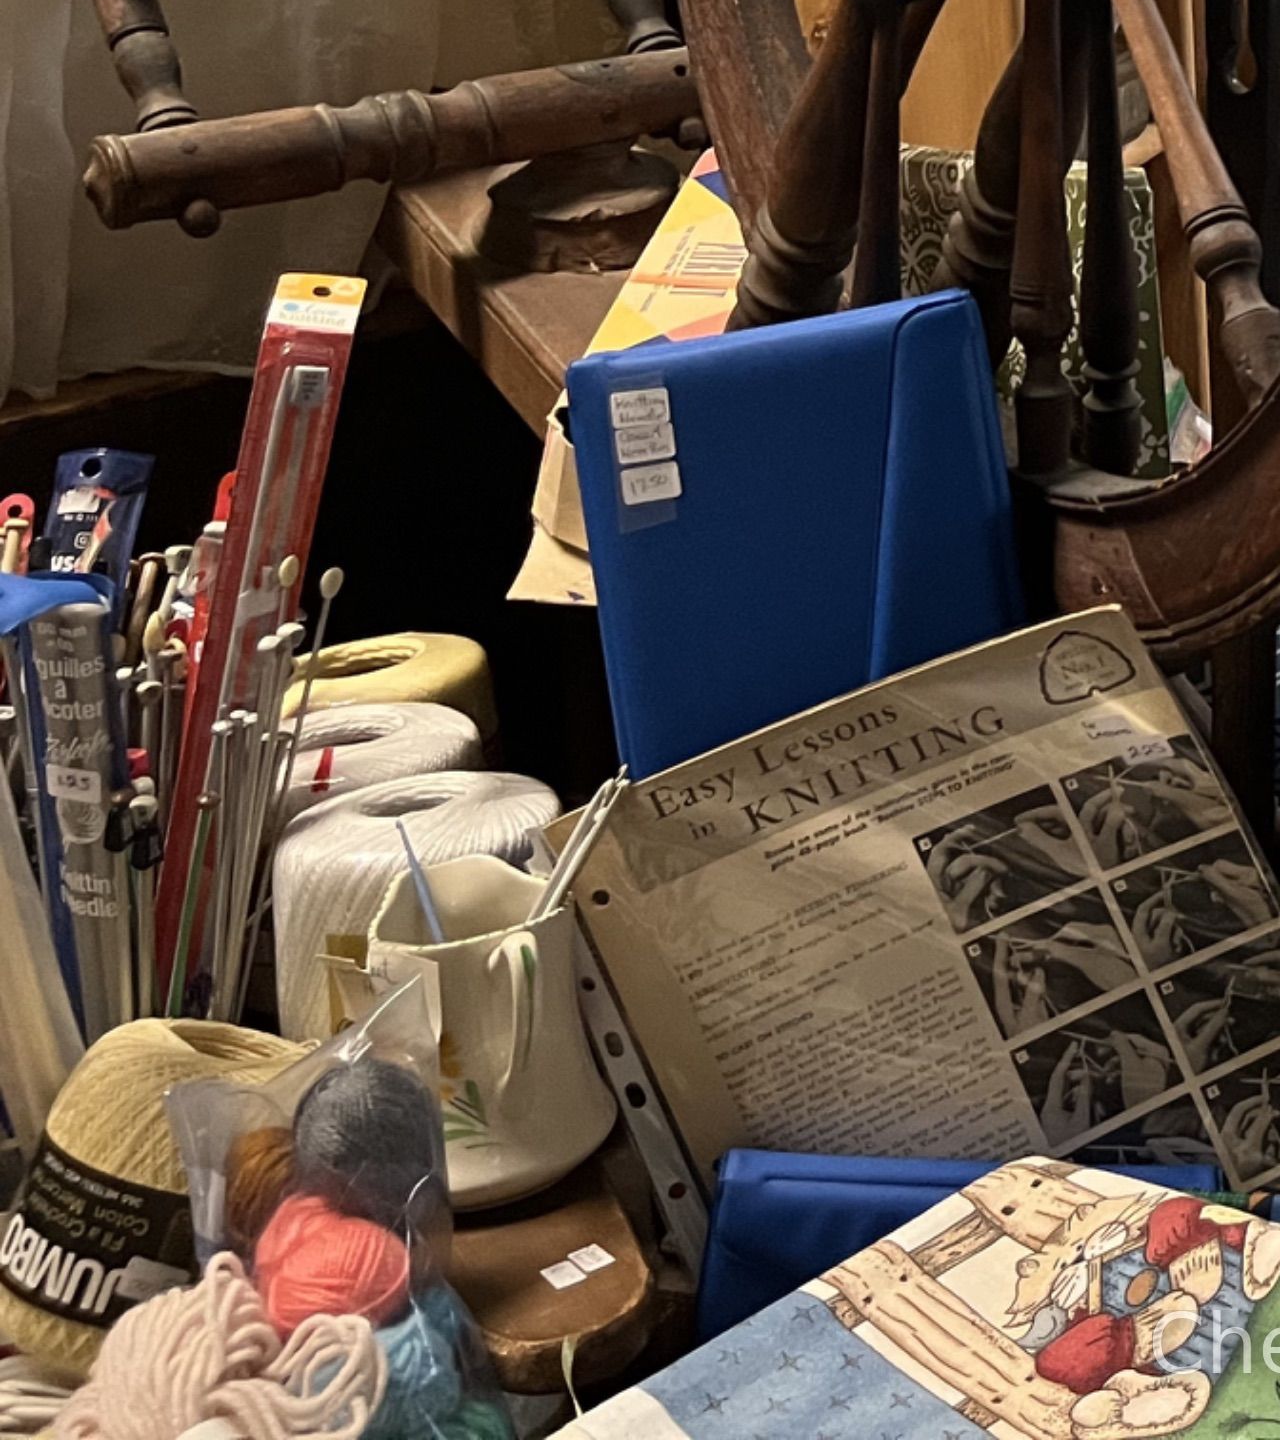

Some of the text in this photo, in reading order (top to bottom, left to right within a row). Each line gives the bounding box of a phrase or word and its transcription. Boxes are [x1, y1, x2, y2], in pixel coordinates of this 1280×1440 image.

[35, 655, 104, 681] guilles
[46, 700, 104, 721] coter
[645, 699, 900, 823] Easy Lessons
[690, 704, 1005, 842] in KNITTING
[63, 871, 111, 895] nittin
[63, 893, 118, 919] eedle
[94, 1205, 150, 1237] Coton
[0, 1213, 122, 1315] JUMBO
